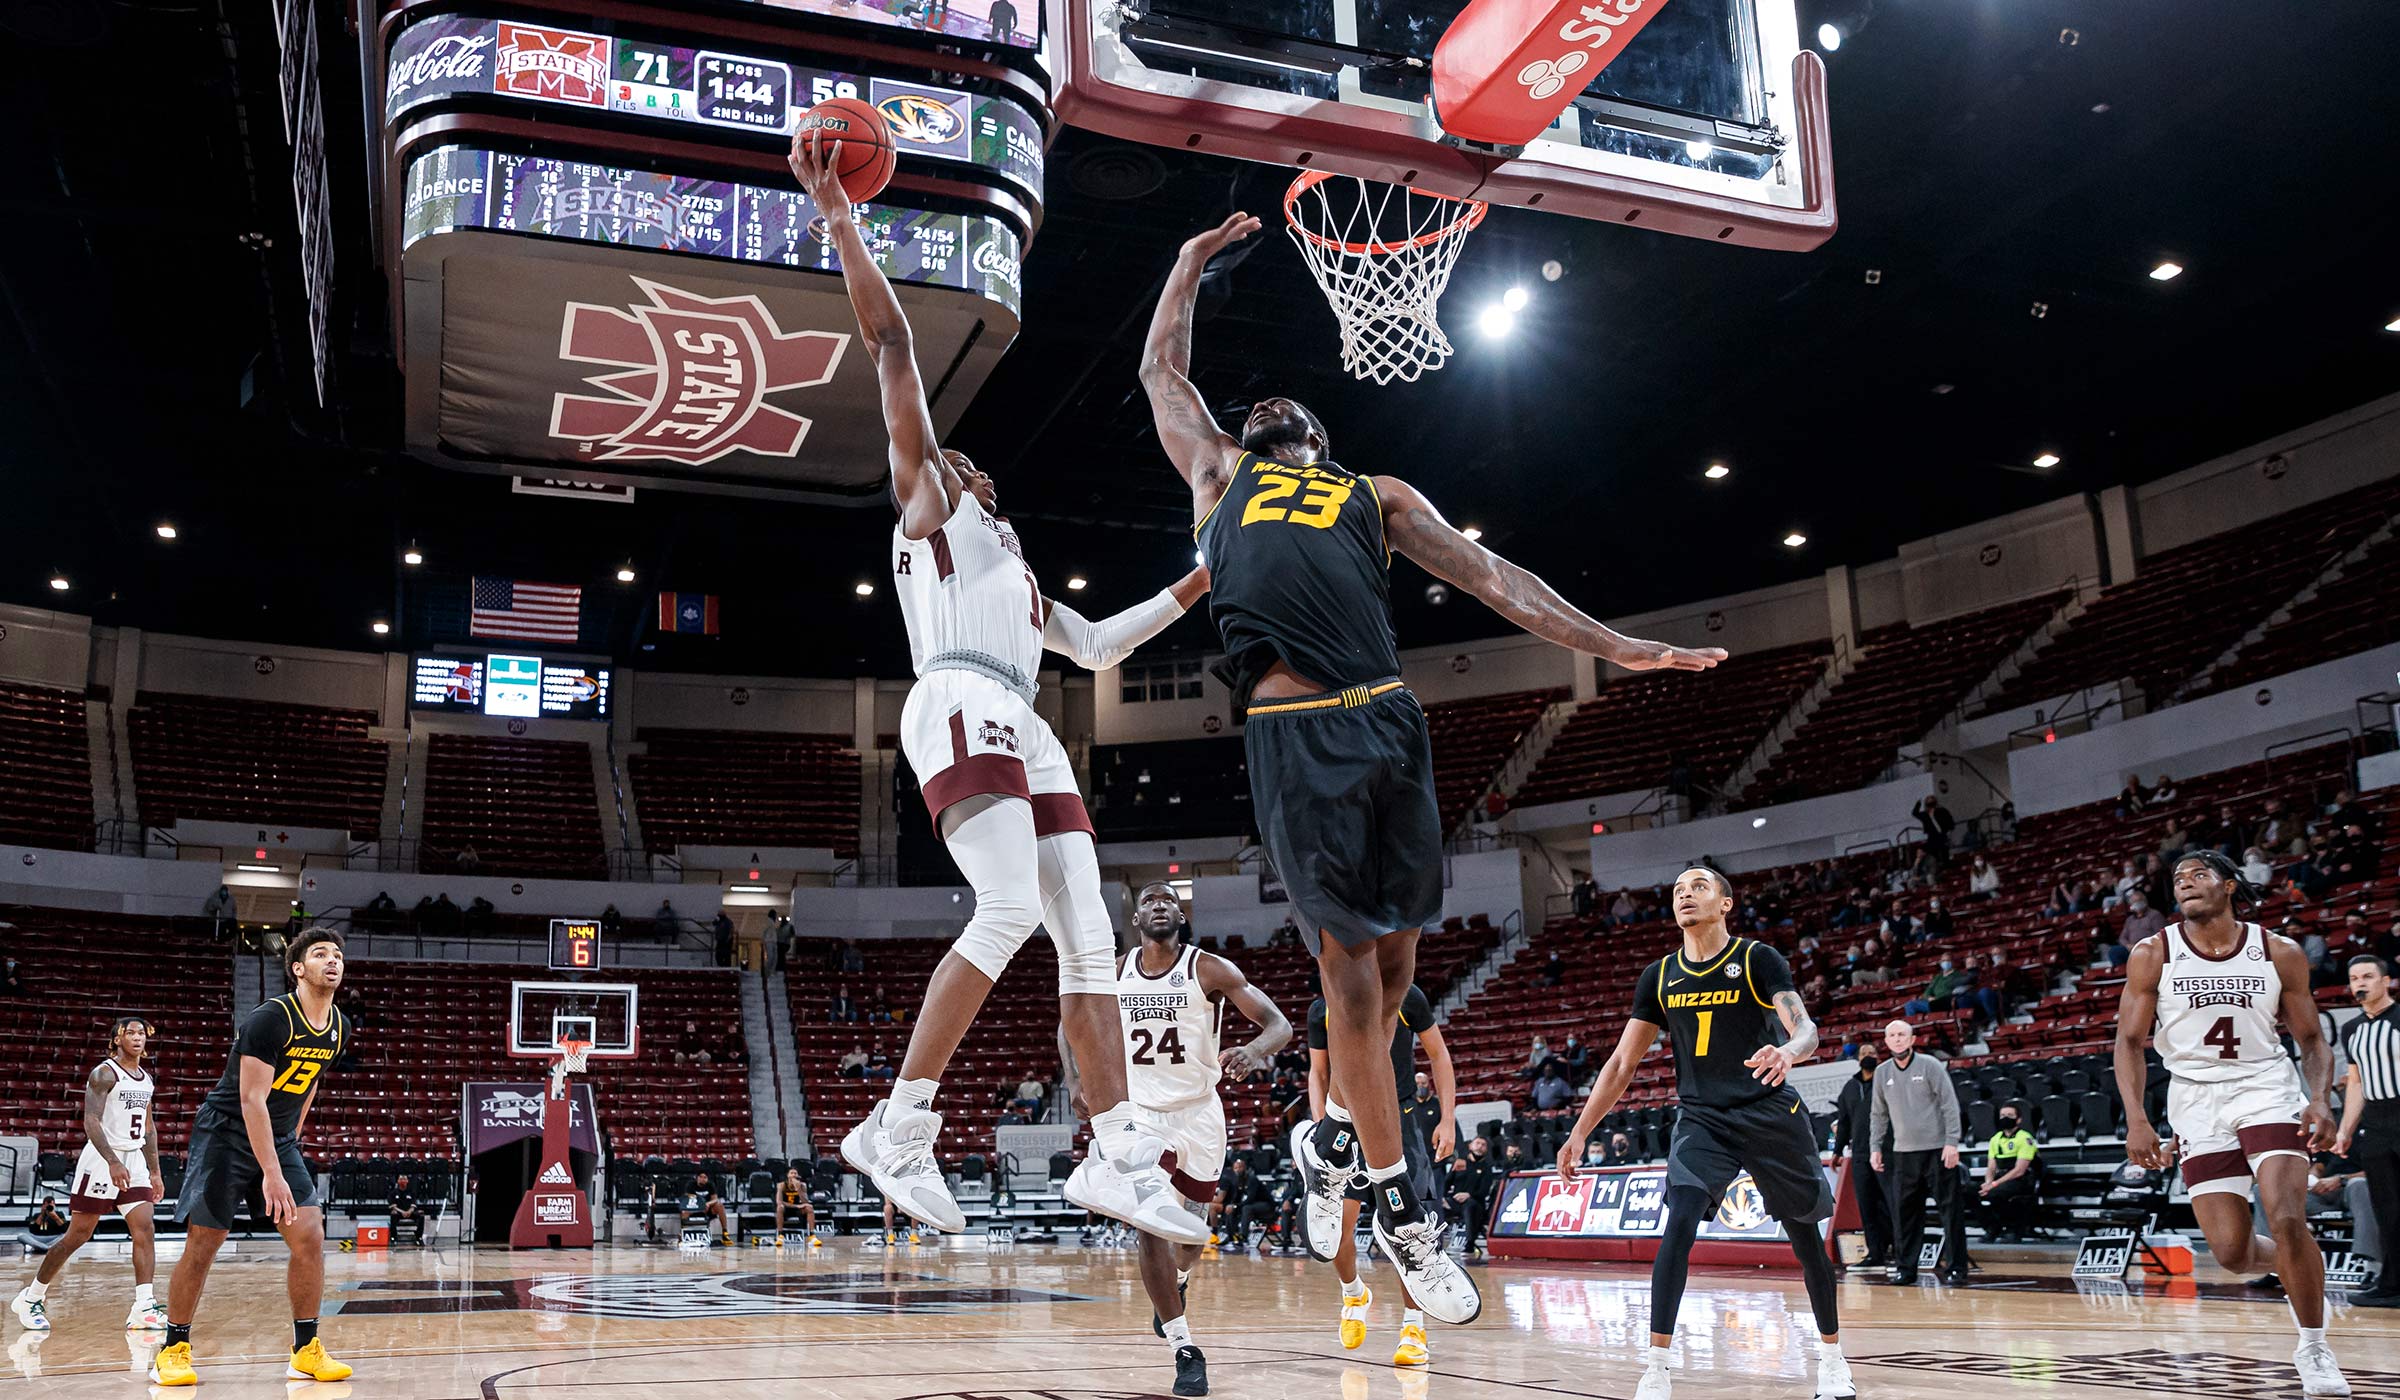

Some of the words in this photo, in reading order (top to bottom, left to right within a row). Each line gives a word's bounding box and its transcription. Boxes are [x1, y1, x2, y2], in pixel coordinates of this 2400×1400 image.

[518, 53, 585, 76] STATE
[633, 51, 670, 85] 71
[726, 62, 762, 77] POSS
[619, 86, 631, 100] 3
[708, 76, 774, 106] 1:44
[812, 77, 858, 105] 59
[615, 101, 636, 111] FLS
[672, 93, 680, 108] 1
[665, 107, 687, 119] TOL
[712, 106, 741, 121] 2ND
[745, 110, 775, 126] Half
[498, 154, 525, 168] PLY
[536, 160, 564, 172] PTS
[573, 164, 599, 177] REB
[608, 169, 632, 182] FLS
[505, 167, 513, 177] 1
[582, 176, 590, 187] 2
[614, 181, 622, 191] 1
[409, 178, 483, 208] CADENCE
[504, 179, 514, 190] 3
[541, 185, 557, 196] 24
[581, 188, 589, 199] 3
[745, 187, 771, 200] PLY
[780, 192, 805, 205] PTS
[504, 192, 513, 203] 4
[544, 196, 553, 208] 4
[612, 206, 619, 217] 1
[636, 191, 655, 203] FG
[682, 195, 723, 212] 27/53
[751, 199, 758, 210] 1
[612, 218, 620, 229] 2
[635, 207, 660, 219] 3PT
[690, 211, 713, 226] 3/6
[750, 211, 759, 222] 4
[788, 216, 796, 227] 7
[499, 217, 516, 229] 24
[543, 223, 552, 234] 4
[579, 227, 587, 238] 7
[612, 231, 619, 242] 1
[635, 222, 650, 234] FT
[680, 225, 722, 242] 14/15
[746, 224, 762, 236] 12
[784, 229, 798, 240] 11
[822, 233, 830, 244] 2
[873, 224, 891, 235] FG
[913, 227, 955, 243] 24/54
[746, 236, 762, 247] 13
[788, 241, 796, 252] 7
[872, 240, 896, 251] 3PT
[922, 242, 955, 257] 5/17
[745, 248, 761, 260] 23
[873, 254, 888, 264] FT
[921, 257, 946, 271] 6/6
[645, 329, 743, 440] STATE
[1240, 474, 1352, 529] 23
[257, 660, 273, 671] 236
[510, 721, 526, 733] 201
[987, 729, 1015, 743] STATE
[258, 831, 267, 842] R
[751, 852, 760, 864] A
[567, 926, 595, 939] 1:44
[574, 940, 590, 965] 6
[2173, 979, 2265, 991] MISSISSIPPI
[1120, 995, 1188, 1007] MISSISSIPPI
[1668, 990, 1740, 1008] MIZZOU
[2198, 993, 2243, 1006] STATE
[1136, 1008, 1169, 1019] STATE
[1695, 1011, 1713, 1056] 1
[2204, 1016, 2241, 1059] 4
[286, 1047, 334, 1060] MIZZOU
[1131, 1027, 1186, 1065] 24
[272, 1060, 321, 1094] 13
[130, 1115, 142, 1140] 5
[540, 1176, 572, 1184] adidas
[1596, 1180, 1619, 1204] 71
[538, 1206, 572, 1215] BUREAU
[547, 1198, 572, 1206] FARM
[368, 1229, 379, 1240] G
[684, 1232, 710, 1243] ALFA
[990, 1229, 1012, 1240] ALFA
[2077, 1247, 2126, 1266] ALFA
